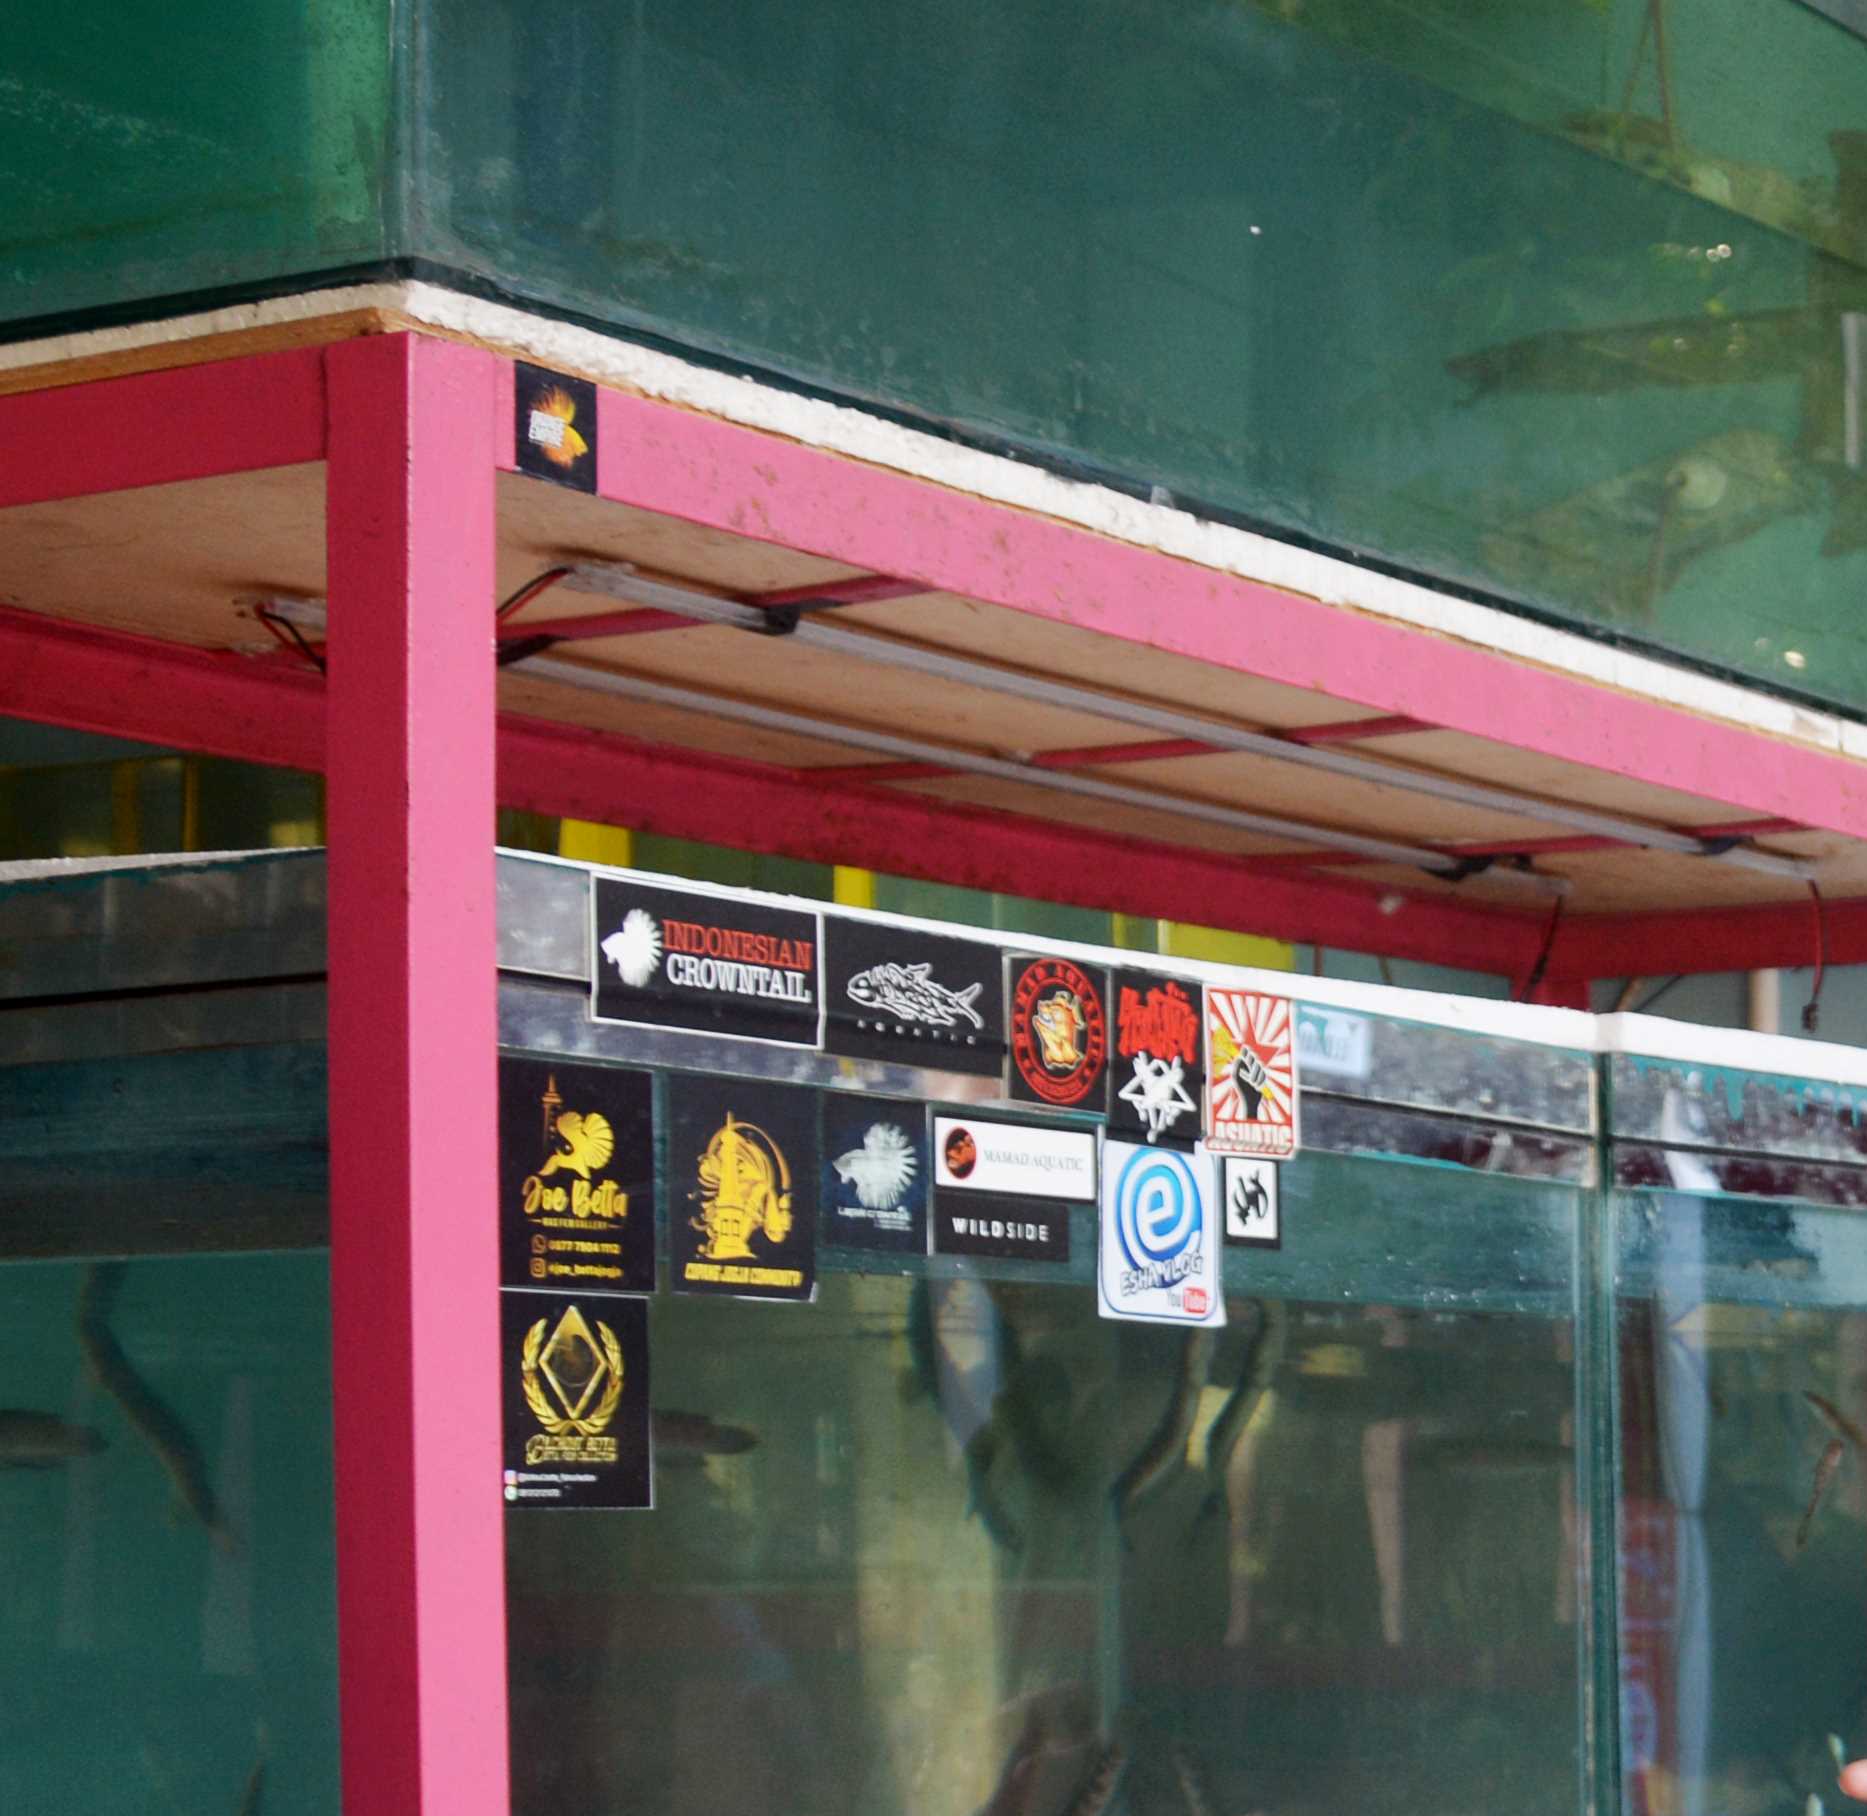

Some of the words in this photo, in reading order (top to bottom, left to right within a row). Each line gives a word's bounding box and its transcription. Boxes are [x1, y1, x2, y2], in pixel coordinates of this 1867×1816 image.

[662, 919, 813, 971] INDONESIAN
[666, 953, 812, 1003] CROWNTAIL
[1032, 1154, 1083, 1172] AQUATIC
[572, 1180, 628, 1218] Betta
